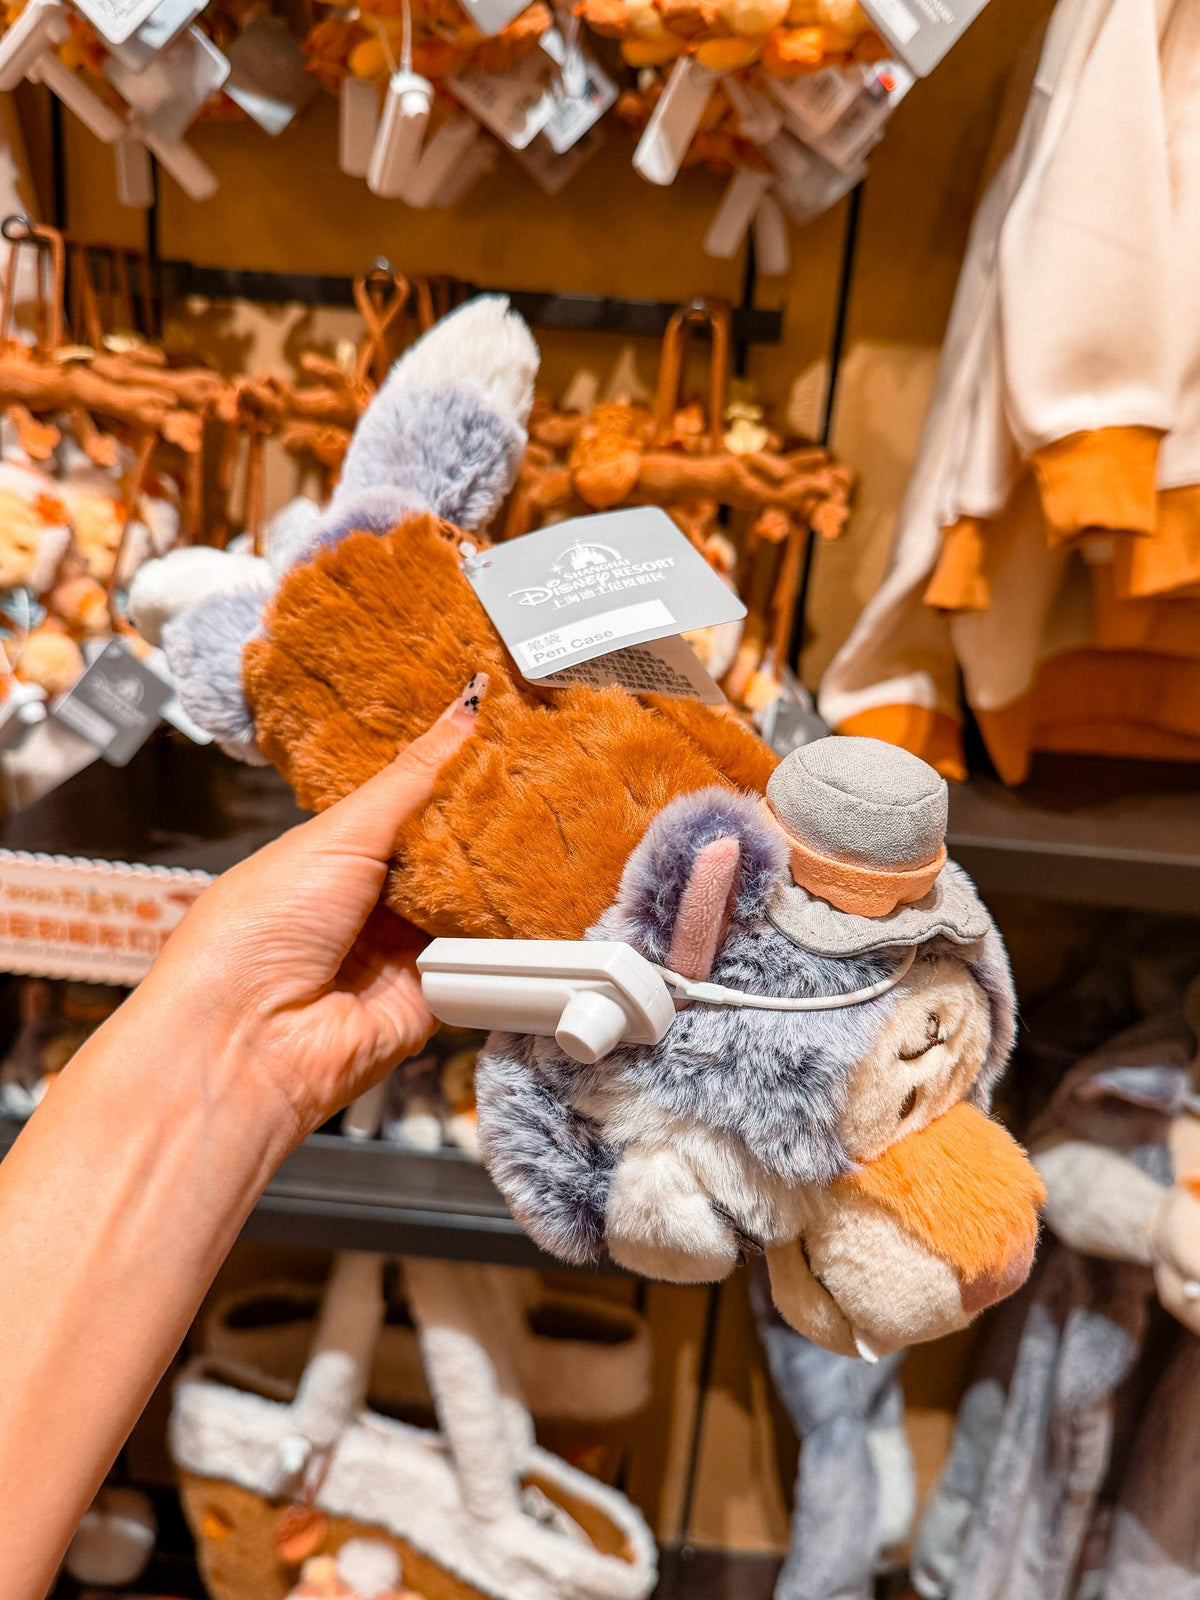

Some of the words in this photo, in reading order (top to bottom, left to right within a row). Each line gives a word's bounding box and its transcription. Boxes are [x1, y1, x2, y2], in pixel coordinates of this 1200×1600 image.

[564, 559, 631, 581] SHANGHAI
[613, 557, 676, 579] RESORT
[527, 633, 562, 652] 笔袋
[533, 646, 567, 663] Pen
[571, 630, 614, 649] Case
